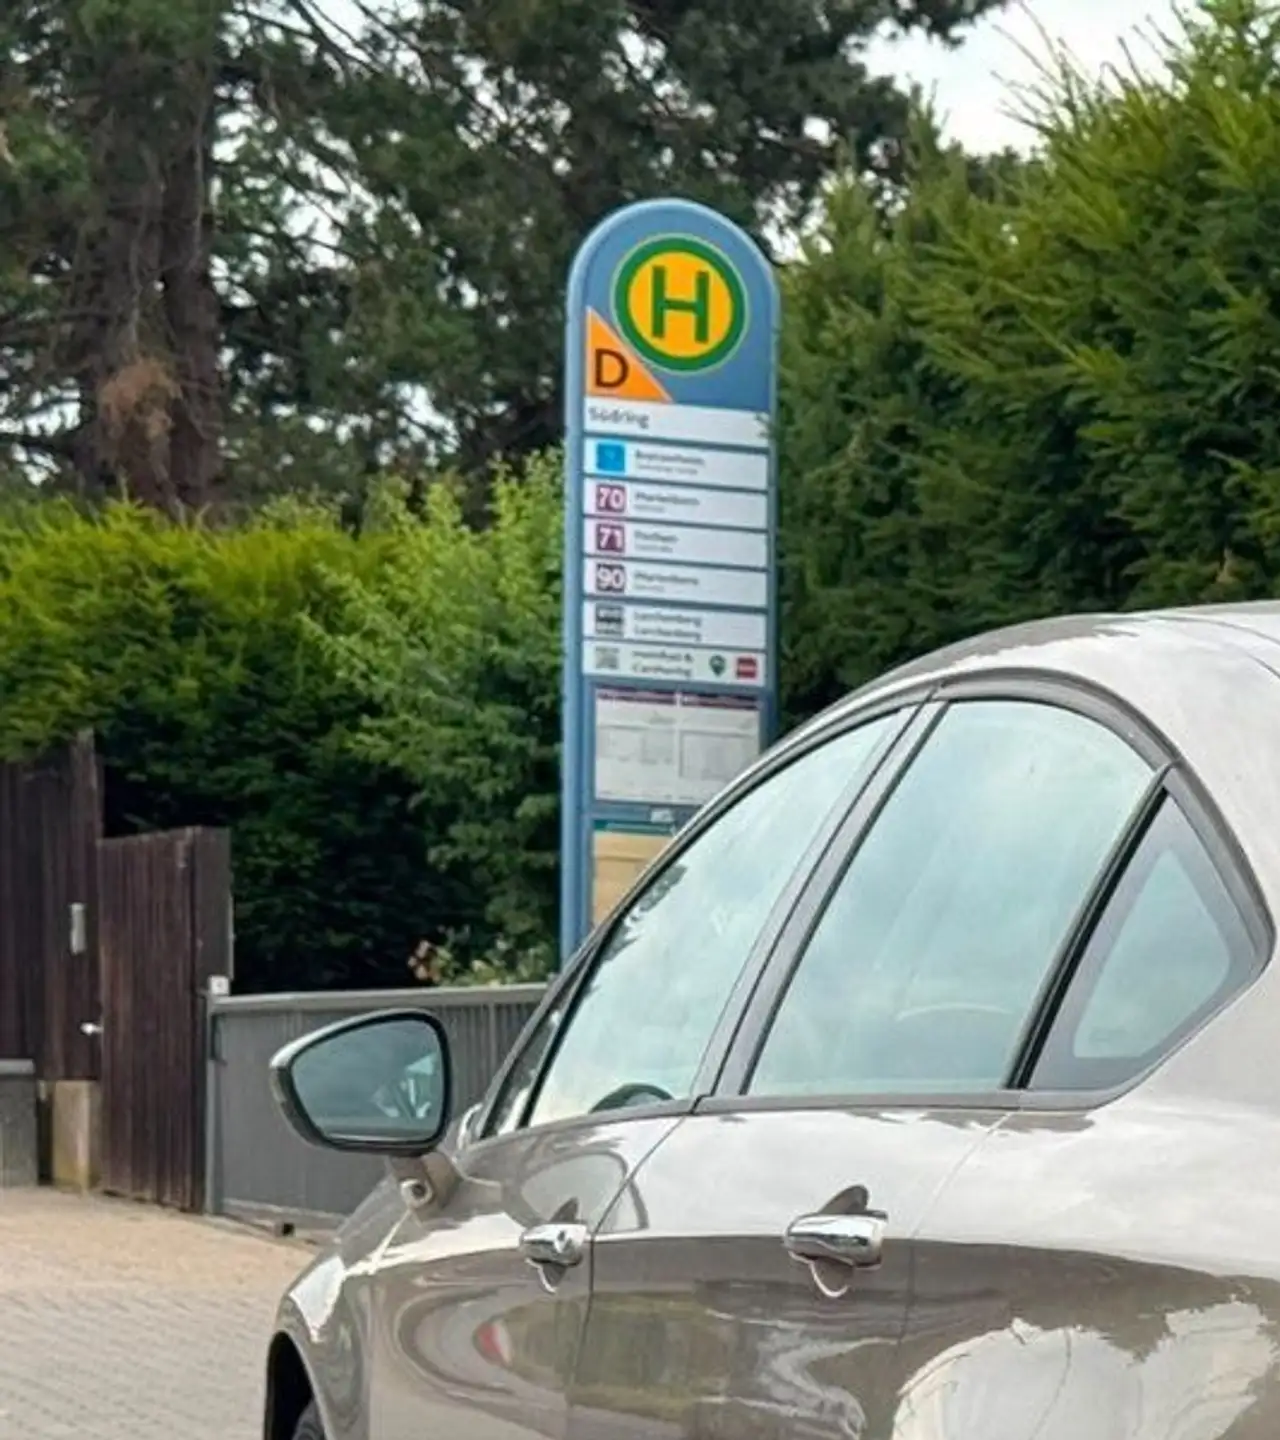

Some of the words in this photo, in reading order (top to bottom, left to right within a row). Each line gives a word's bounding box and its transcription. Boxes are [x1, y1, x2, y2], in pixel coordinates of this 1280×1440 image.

[652, 265, 710, 343] H
[595, 348, 629, 388] D
[599, 487, 625, 511] 70
[599, 526, 624, 550] 71
[597, 567, 625, 590] 90
